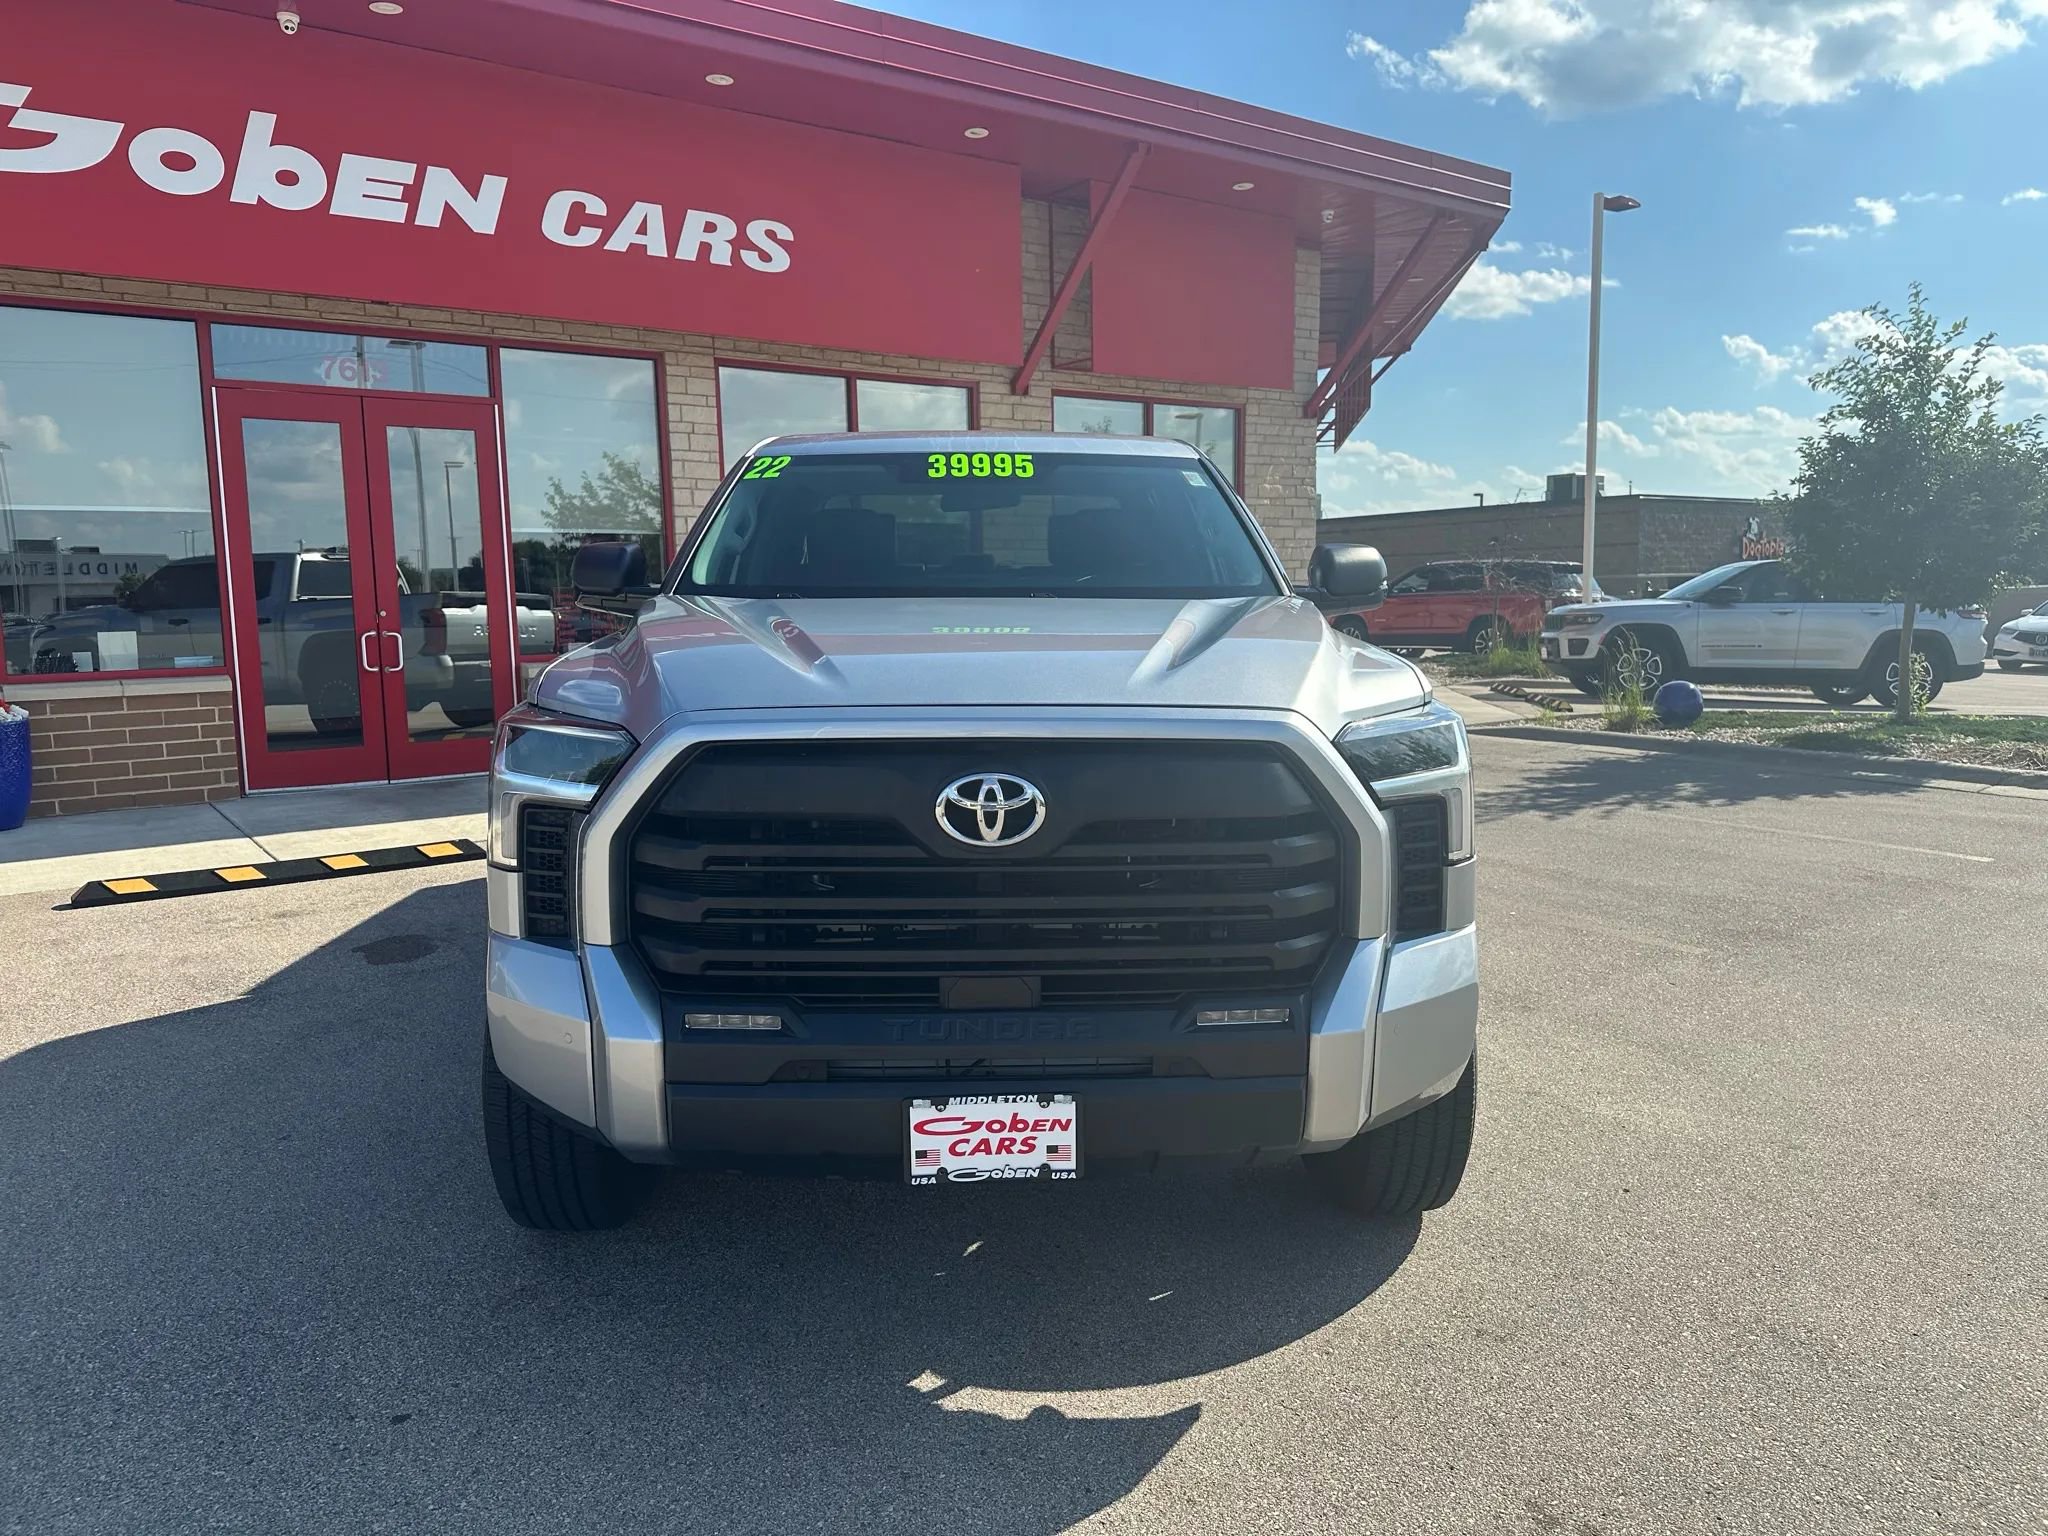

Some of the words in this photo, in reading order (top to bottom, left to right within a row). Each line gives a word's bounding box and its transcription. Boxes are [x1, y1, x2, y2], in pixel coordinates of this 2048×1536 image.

[541, 190, 795, 273] CARS
[744, 455, 791, 480] 22
[927, 452, 1035, 479] 39995
[881, 1016, 1098, 1041] TUNDRA
[948, 1094, 1039, 1106] MIDDLETON
[948, 1135, 1039, 1157] CARS
[911, 1176, 937, 1185] USA
[1051, 1171, 1077, 1180] USA
